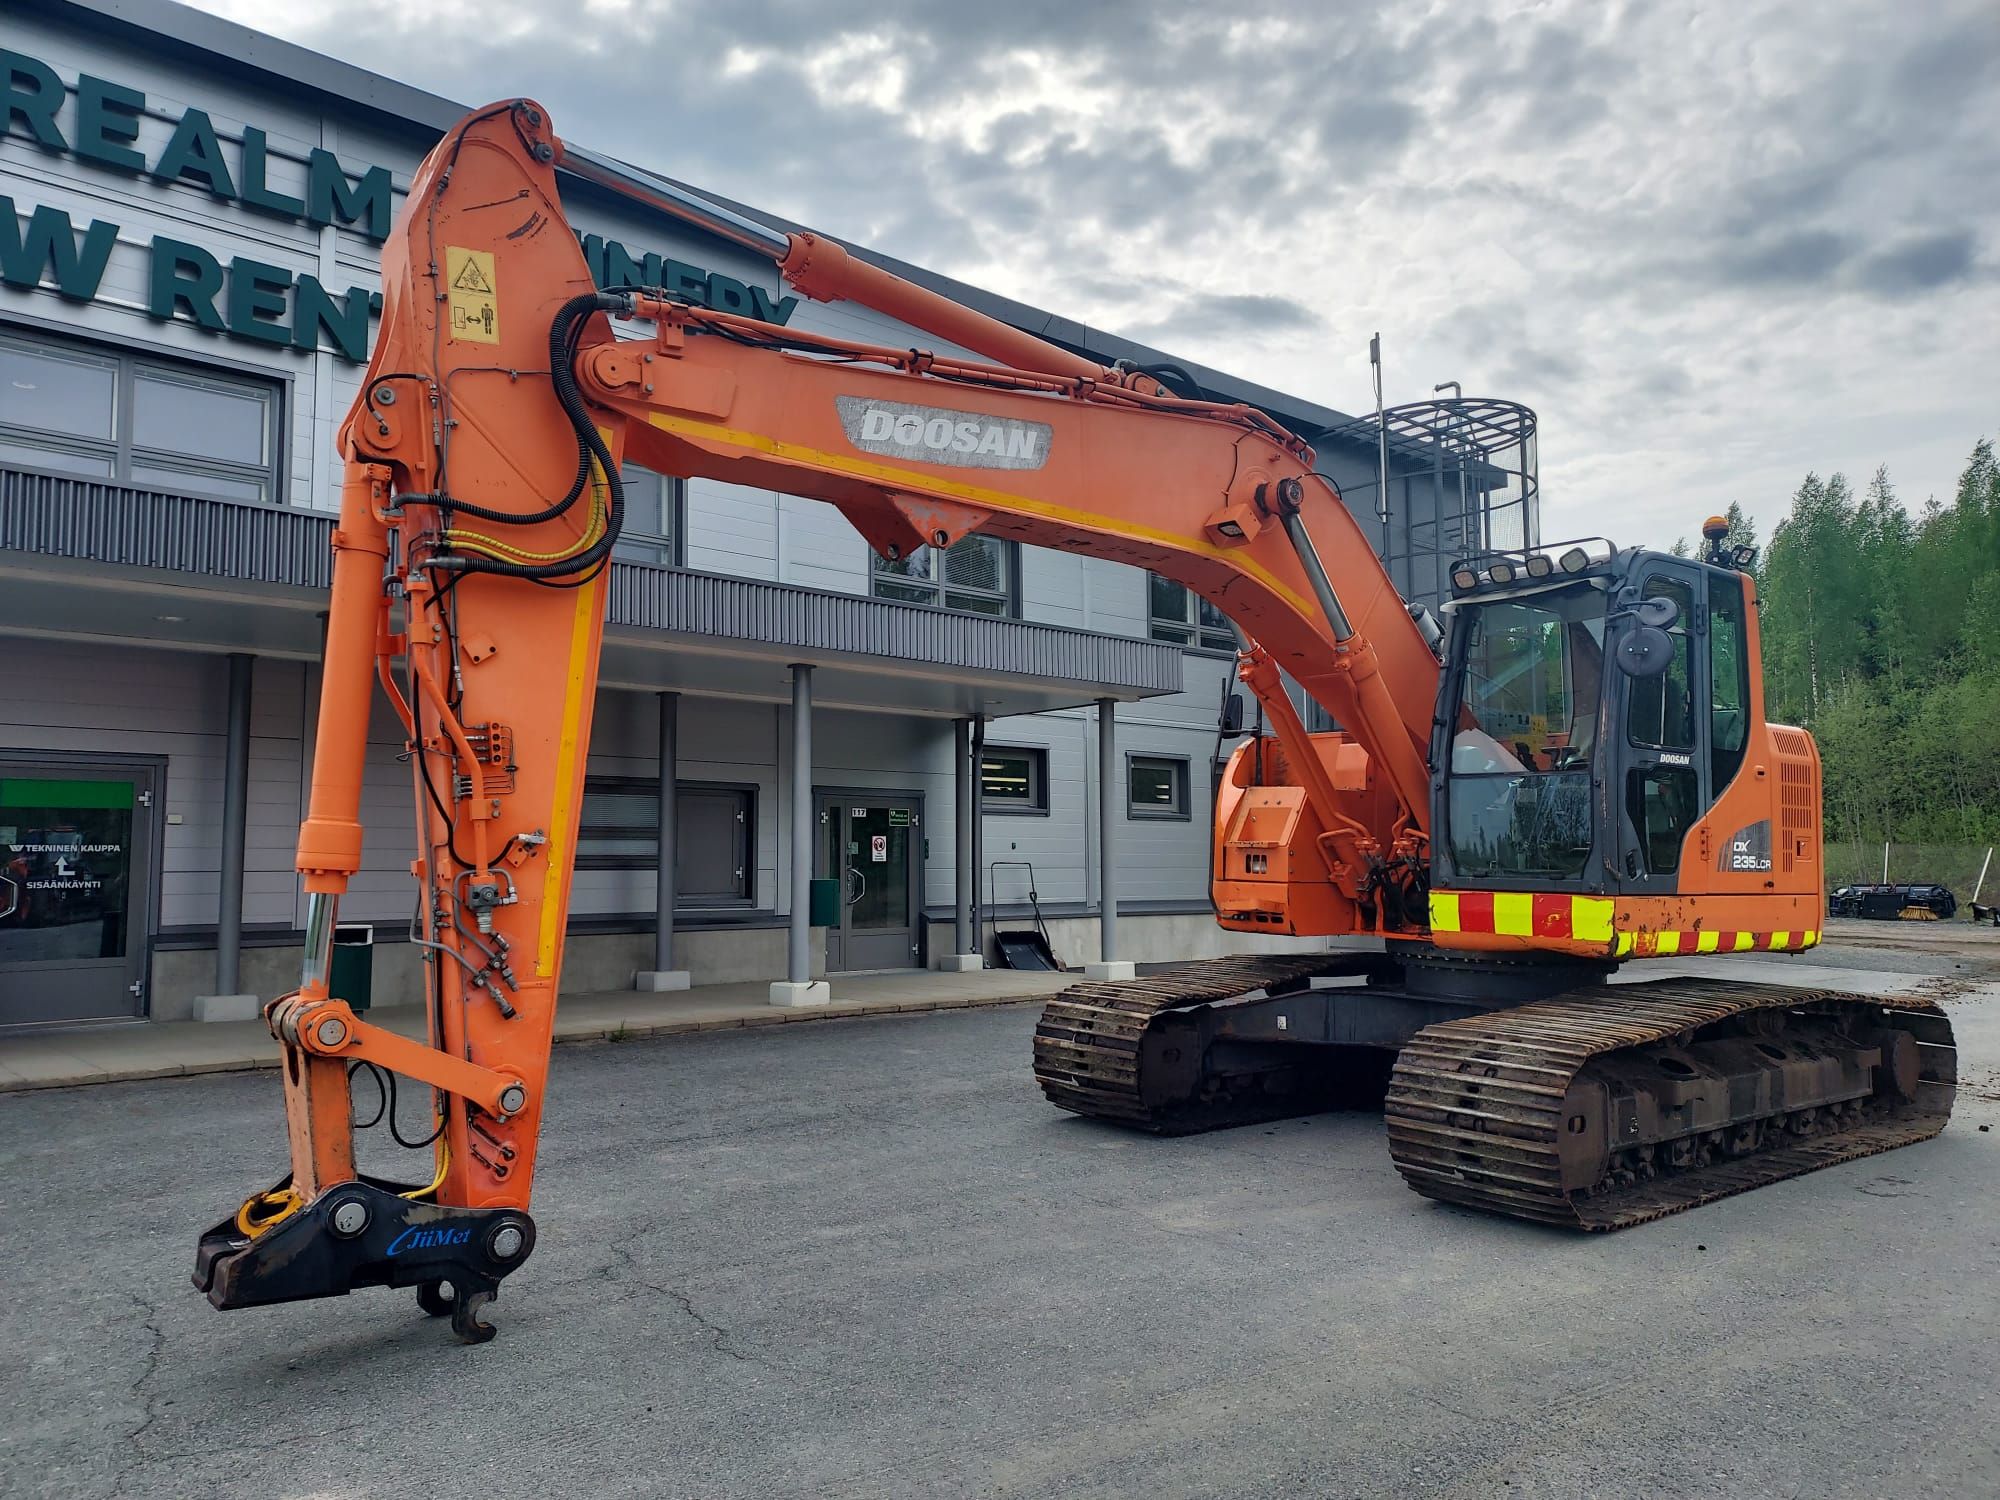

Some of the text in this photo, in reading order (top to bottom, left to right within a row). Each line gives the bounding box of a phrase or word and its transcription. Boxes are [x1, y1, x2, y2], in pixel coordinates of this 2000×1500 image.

[150, 234, 383, 364] REN
[862, 409, 1038, 459] DOOSAN
[1660, 754, 1690, 765] DOOSAN
[25, 844, 78, 852] TEKNINEN
[80, 844, 121, 852] KAUPPA
[1733, 840, 1751, 852] DX
[26, 880, 101, 889] SISÄÄNKÄYNTI
